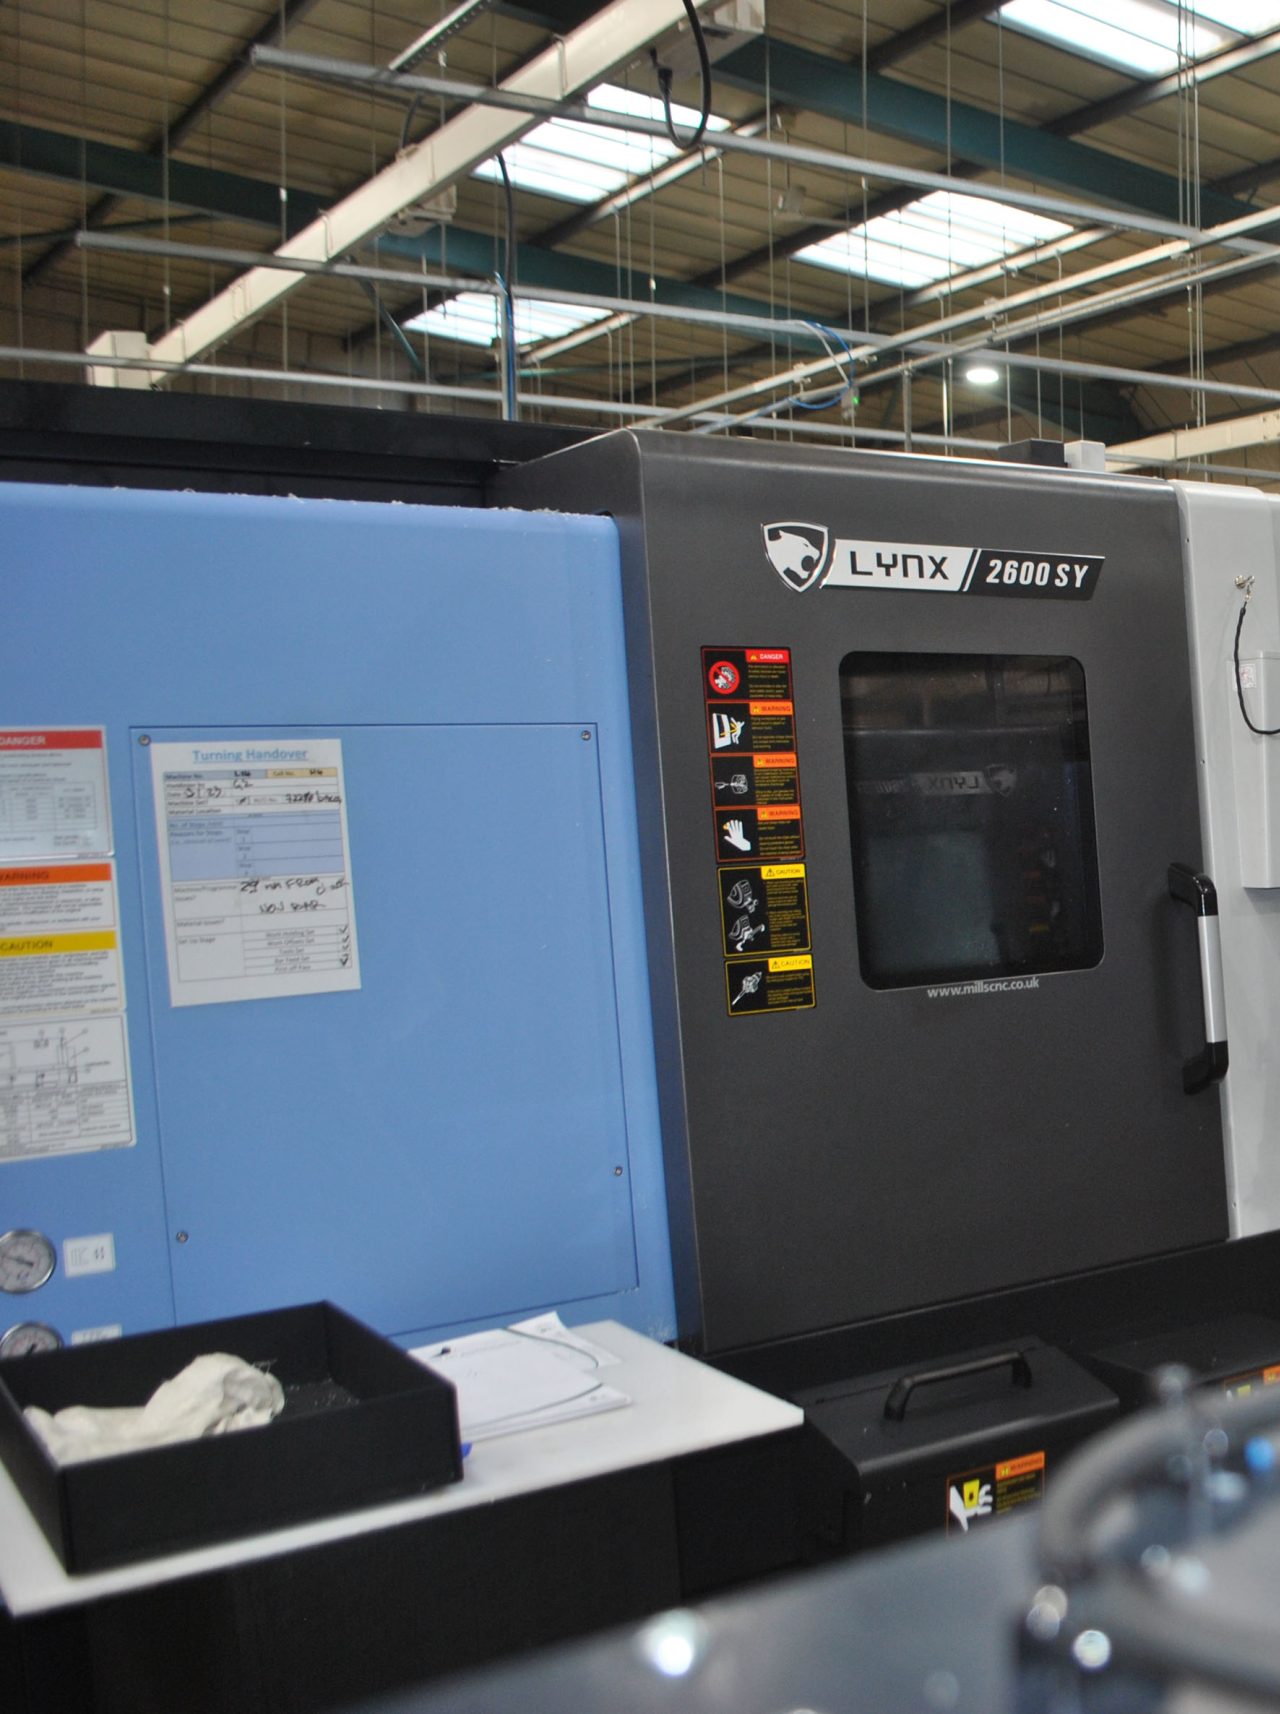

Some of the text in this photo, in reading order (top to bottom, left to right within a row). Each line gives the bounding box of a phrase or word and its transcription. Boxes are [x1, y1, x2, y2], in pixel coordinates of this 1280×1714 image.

[850, 550, 1088, 589] LYNX 2600 SY
[192, 748, 308, 762] Turning Handover
[775, 868, 801, 876] CAUTION
[781, 959, 810, 967] CAUTION
[926, 976, 1040, 999] www.millscnc.co.uk
